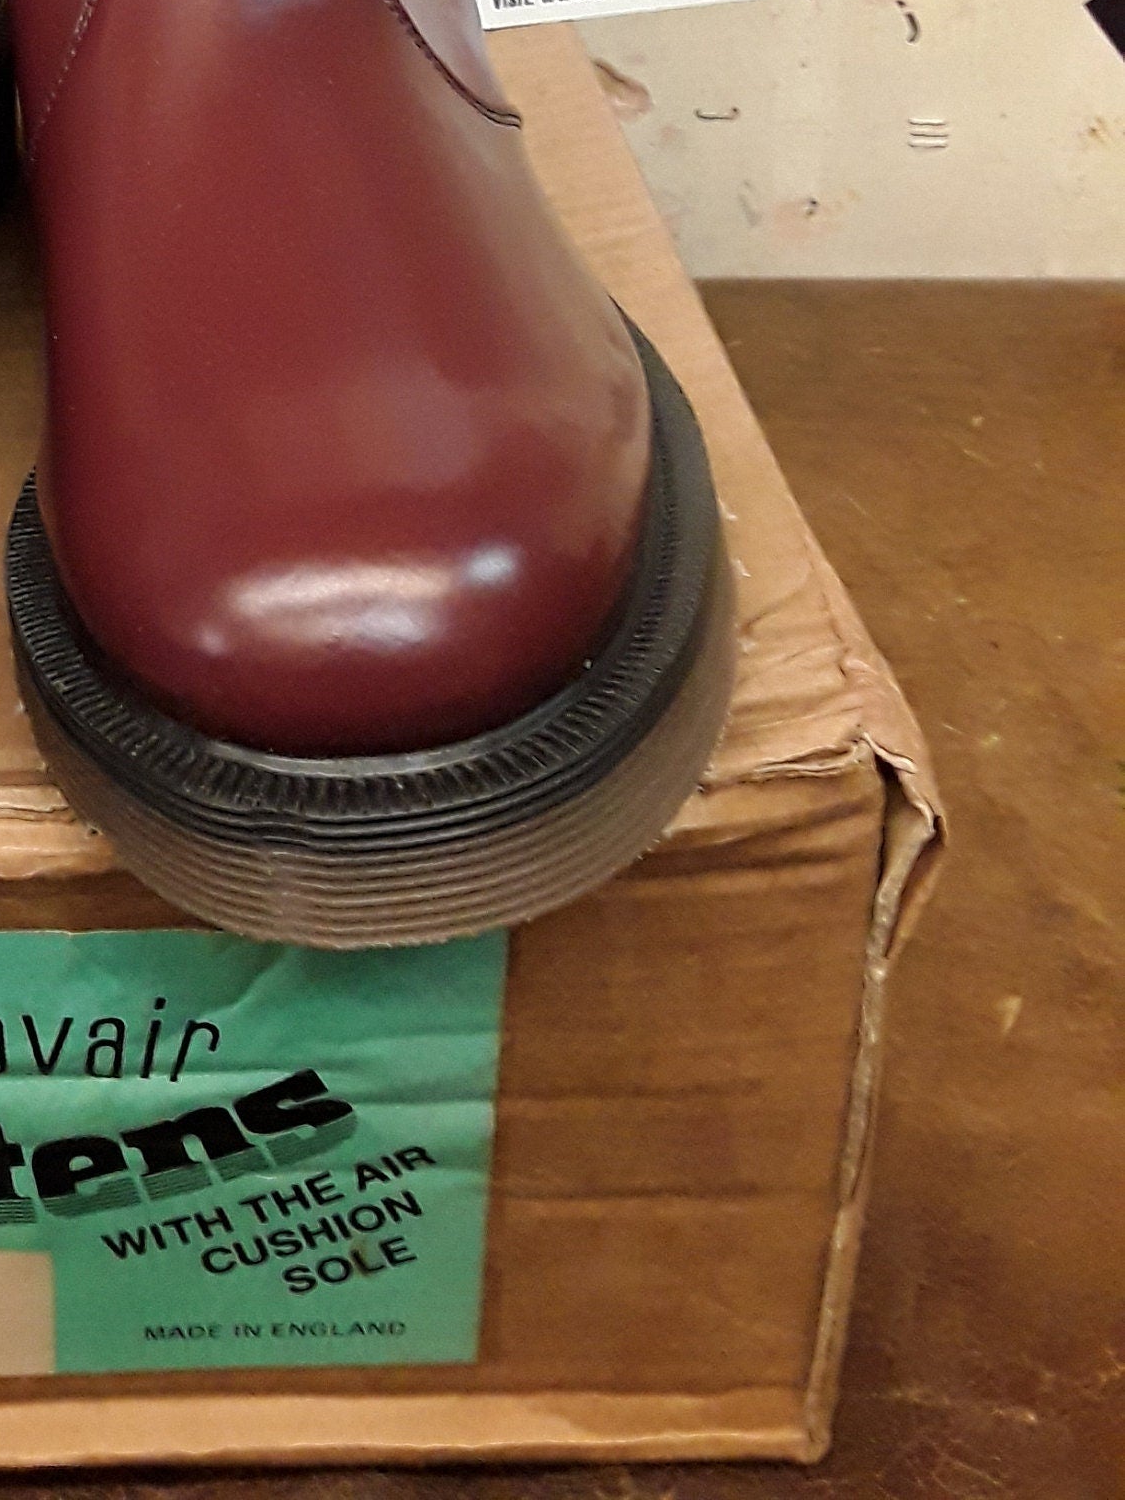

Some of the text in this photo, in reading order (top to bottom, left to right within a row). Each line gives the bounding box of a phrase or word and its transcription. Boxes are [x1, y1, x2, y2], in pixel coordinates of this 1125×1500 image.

[101, 1145, 437, 1260] WITH THE AIR
[201, 1190, 423, 1274] CUSHION
[282, 1236, 418, 1295] SOLE
[144, 1320, 406, 1341] MADE IN ENGLAND
